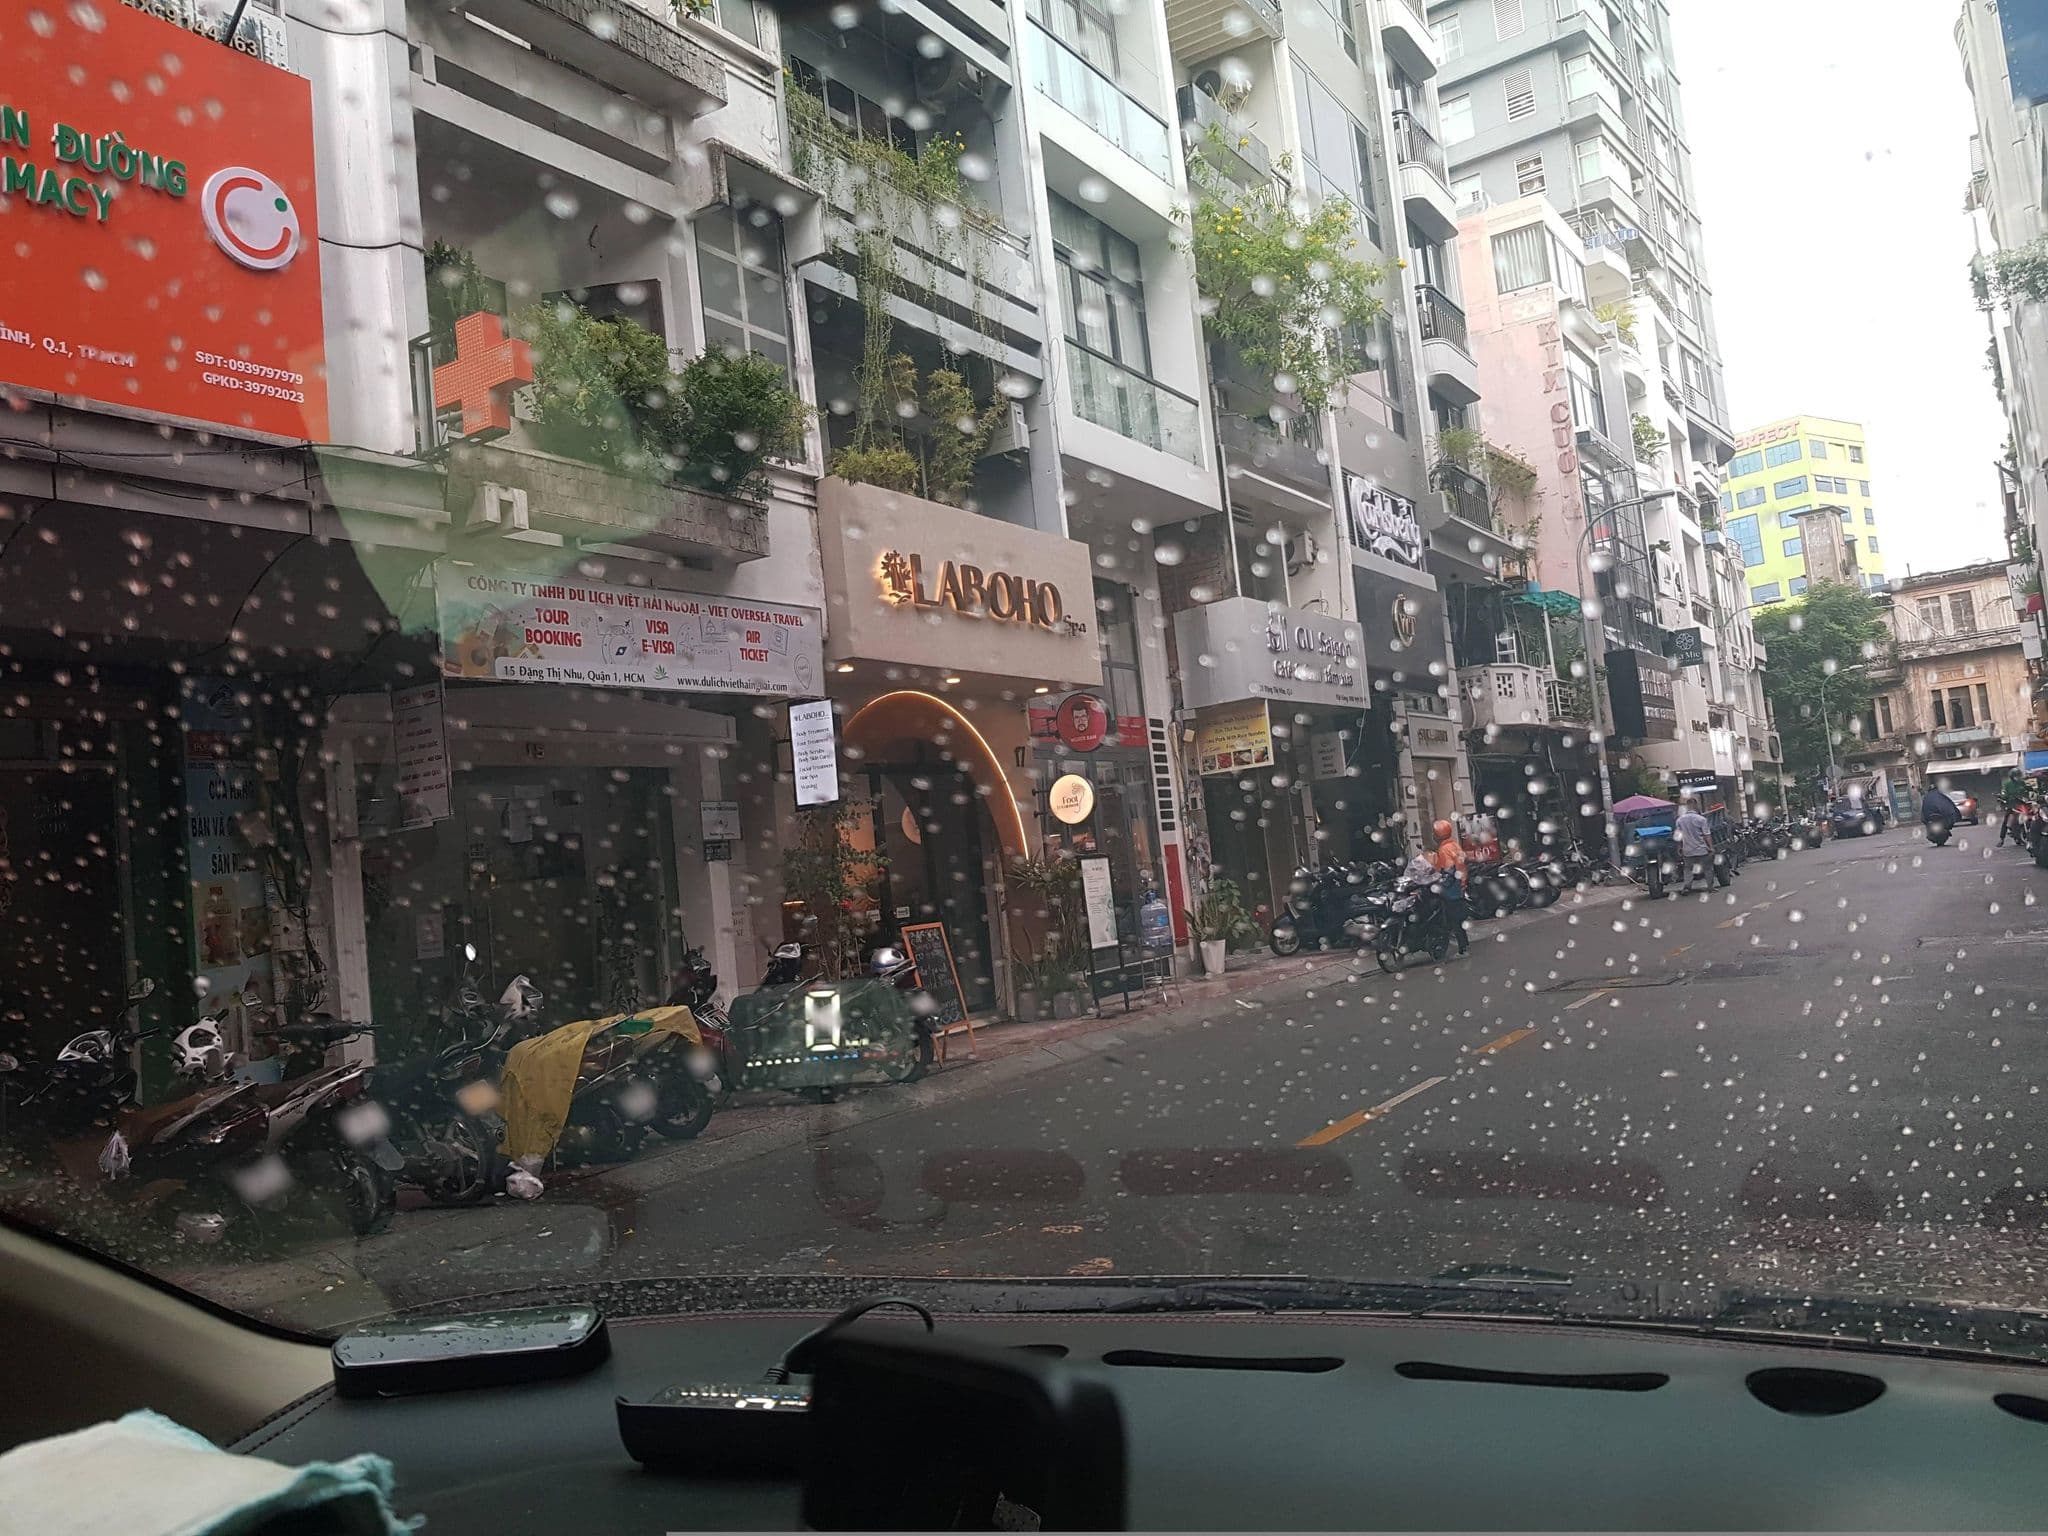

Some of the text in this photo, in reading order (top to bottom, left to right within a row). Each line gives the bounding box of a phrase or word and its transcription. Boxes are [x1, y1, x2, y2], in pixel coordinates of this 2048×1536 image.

[51, 121, 187, 197] ĐƯỜNG
[2, 155, 113, 222] MACY
[511, 581, 527, 595] TY
[530, 584, 565, 600] TNHH
[569, 588, 585, 602] DU
[588, 591, 614, 606] LỊCH
[617, 592, 640, 610] VIỆT
[707, 604, 729, 619] VIET
[731, 608, 771, 623] OVERSEA
[773, 613, 804, 628] TRAVEL
[909, 553, 1087, 637] LABOHO Spa
[535, 607, 570, 626] TOUR
[645, 619, 669, 635] VISA
[746, 629, 761, 644] AIR
[525, 628, 582, 648] BOOKING
[642, 638, 675, 655] E-VISA
[740, 647, 769, 662] TICKET
[503, 665, 516, 676] 15
[519, 665, 544, 681] Đặng
[546, 667, 561, 680] Thị
[587, 670, 611, 684] Quận
[623, 673, 646, 684] HCM
